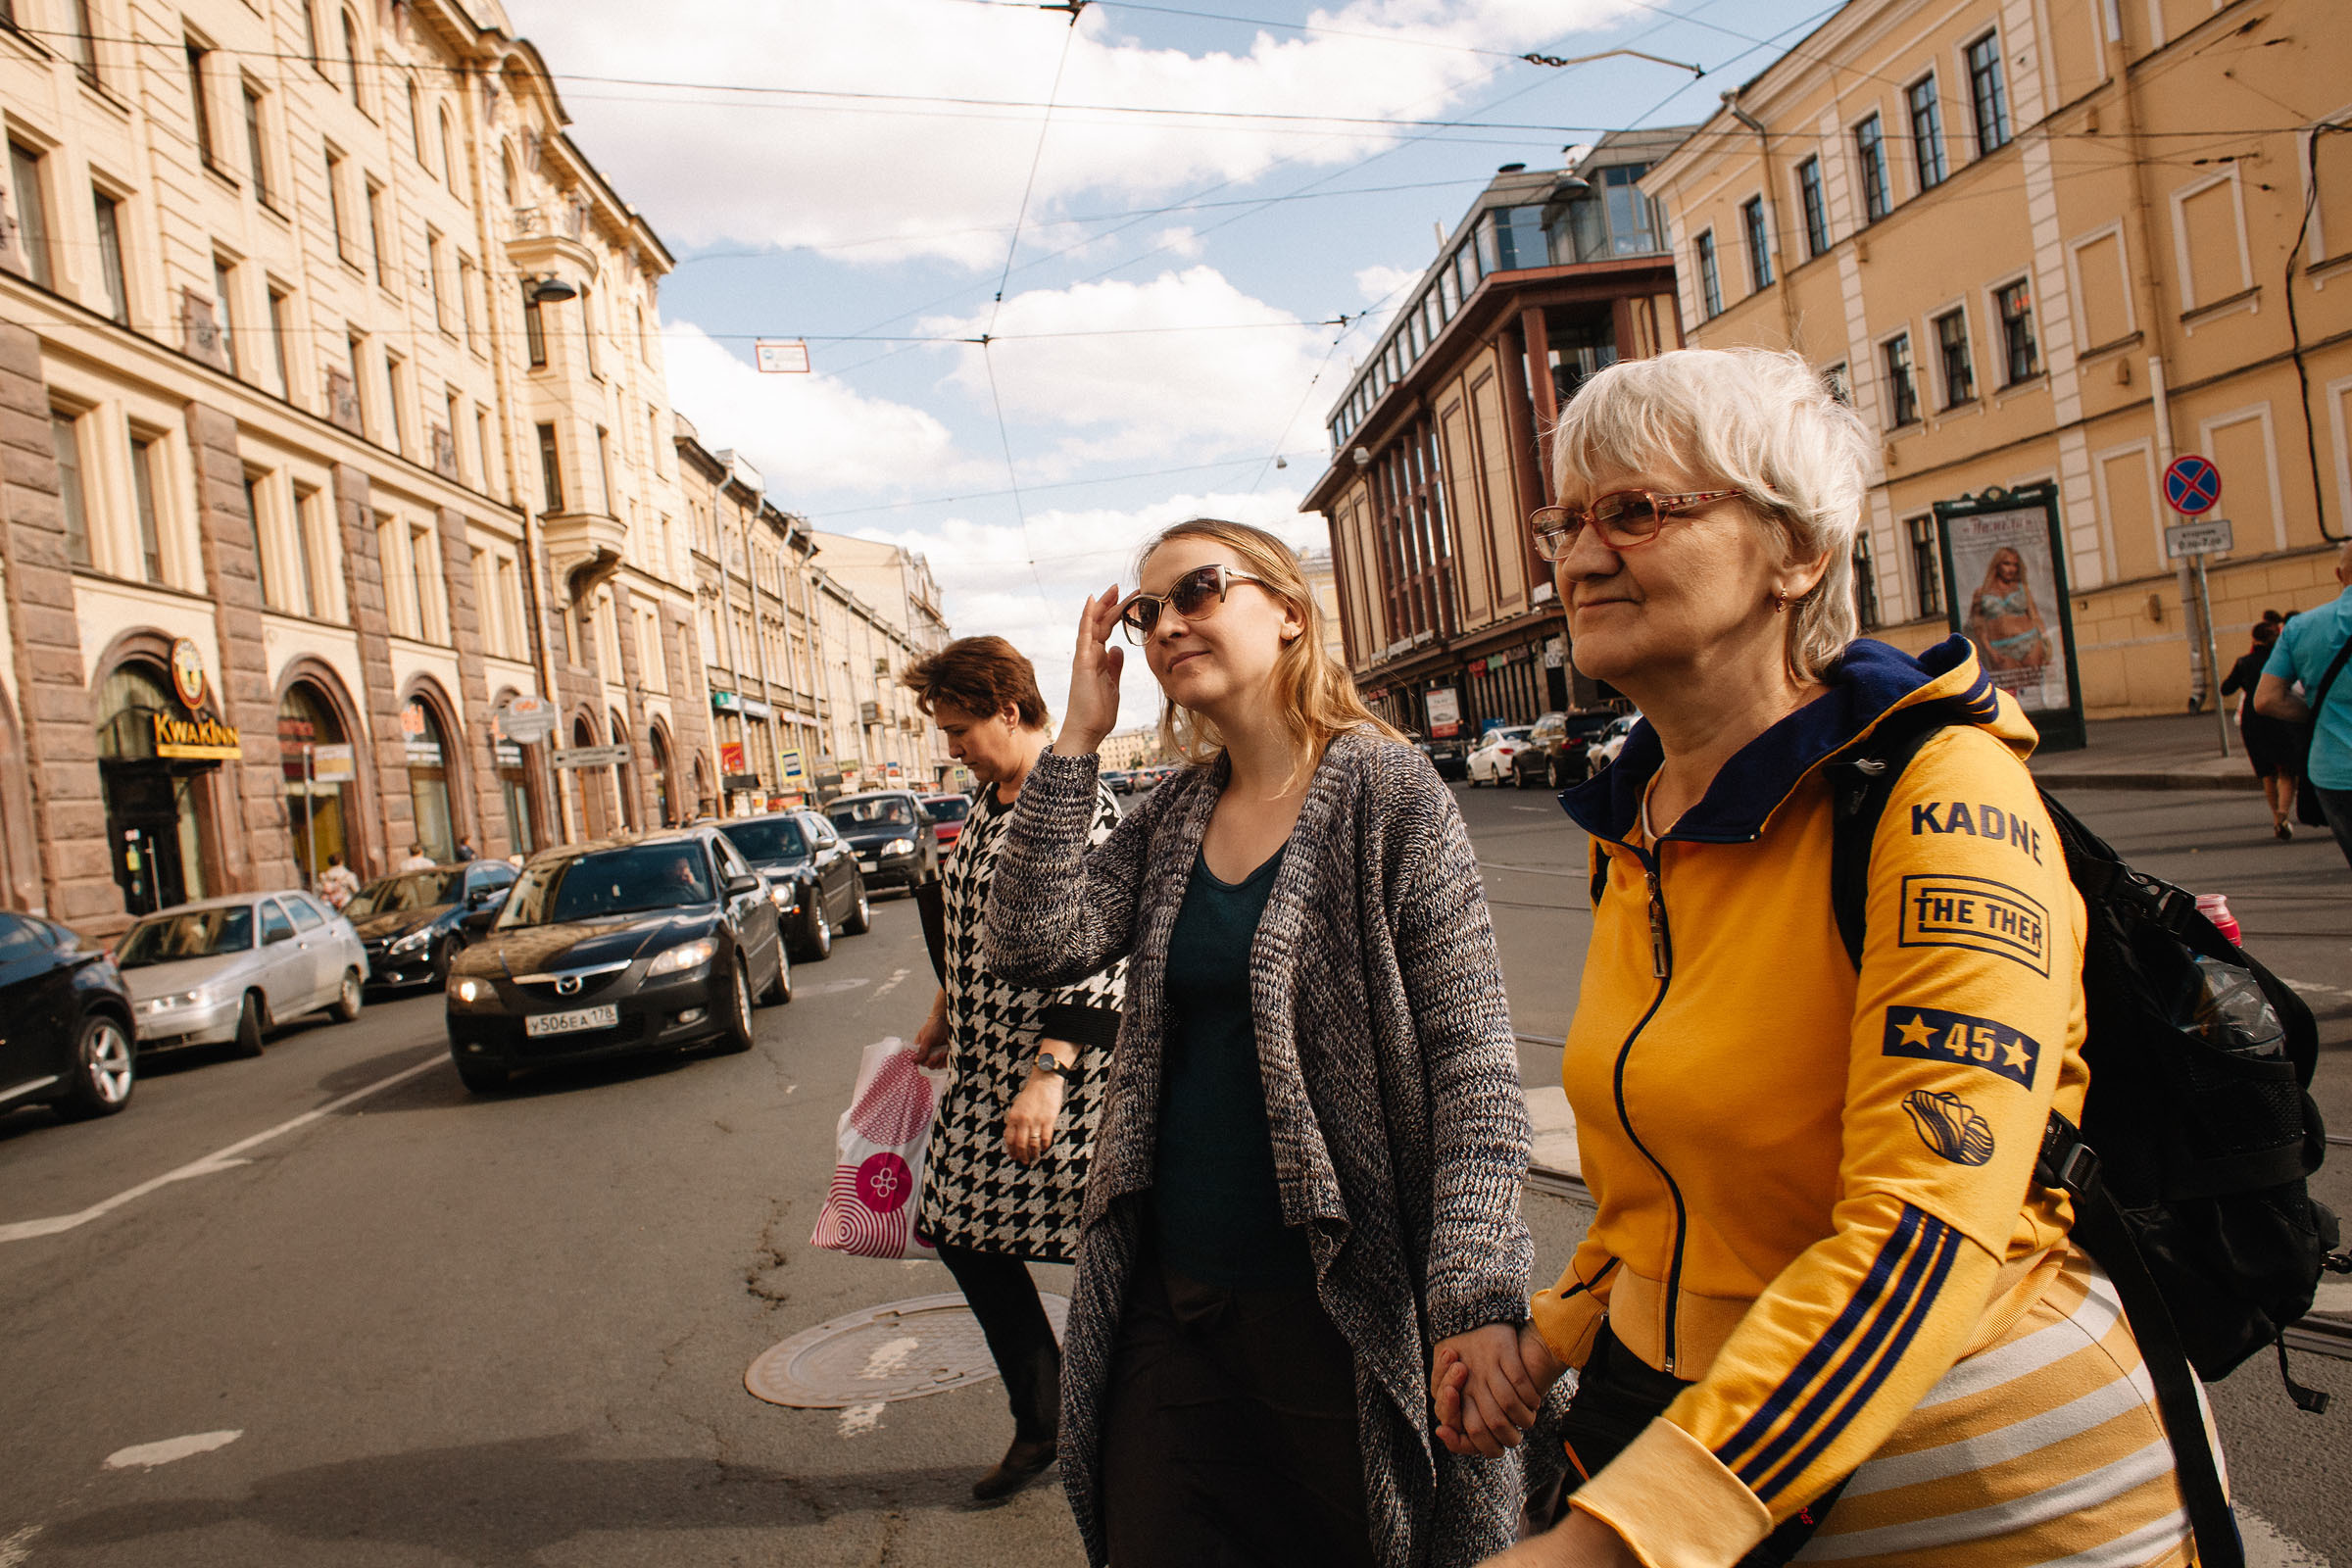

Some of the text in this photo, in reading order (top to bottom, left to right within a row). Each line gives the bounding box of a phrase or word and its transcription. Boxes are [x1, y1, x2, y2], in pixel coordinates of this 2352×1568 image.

[1912, 803, 2042, 866] KADNE
[1914, 898, 2041, 949] THE THER
[1944, 1022, 1996, 1061] 45
